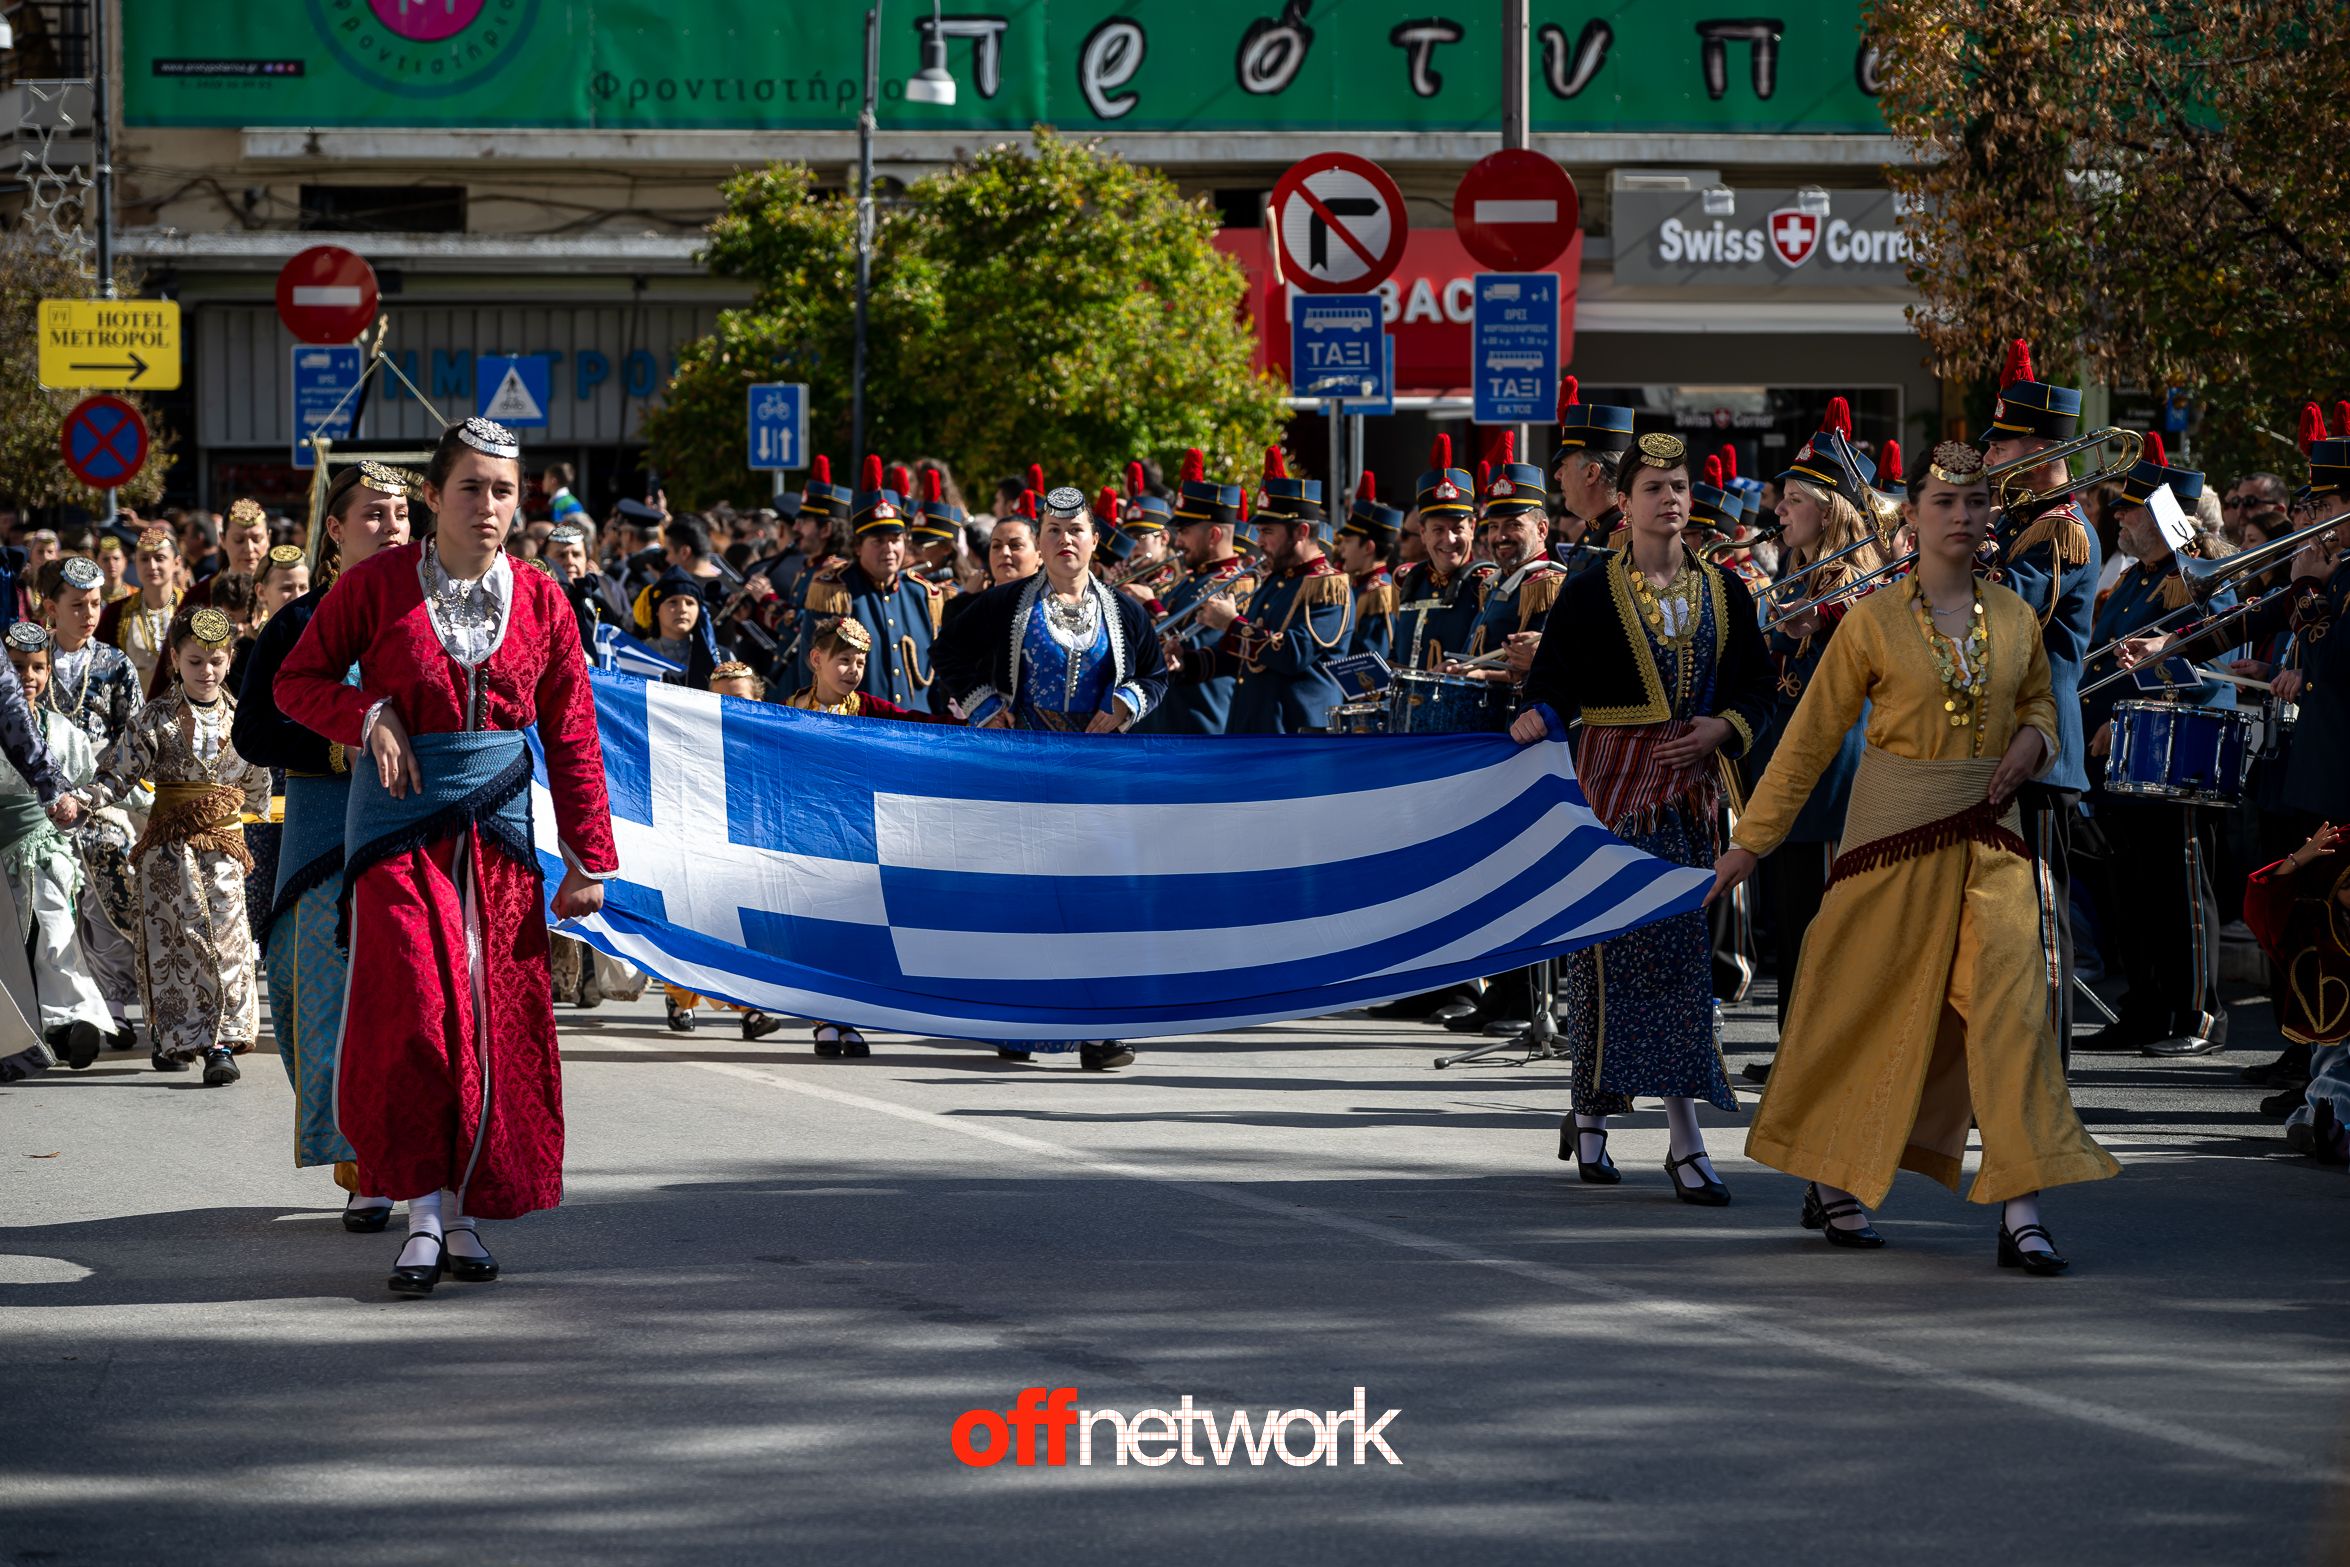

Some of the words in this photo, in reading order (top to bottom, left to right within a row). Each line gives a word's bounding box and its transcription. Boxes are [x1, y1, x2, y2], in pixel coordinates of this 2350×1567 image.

[591, 71, 905, 108] Φροντιστήρο
[1659, 217, 1765, 263] Swiss
[1826, 218, 1936, 264] Corn
[97, 311, 169, 329] HOTEL
[49, 330, 169, 348] METROPOL
[1306, 342, 1370, 365] ΤΑΞΙ
[1489, 378, 1541, 397] ΤΑΞΙ
